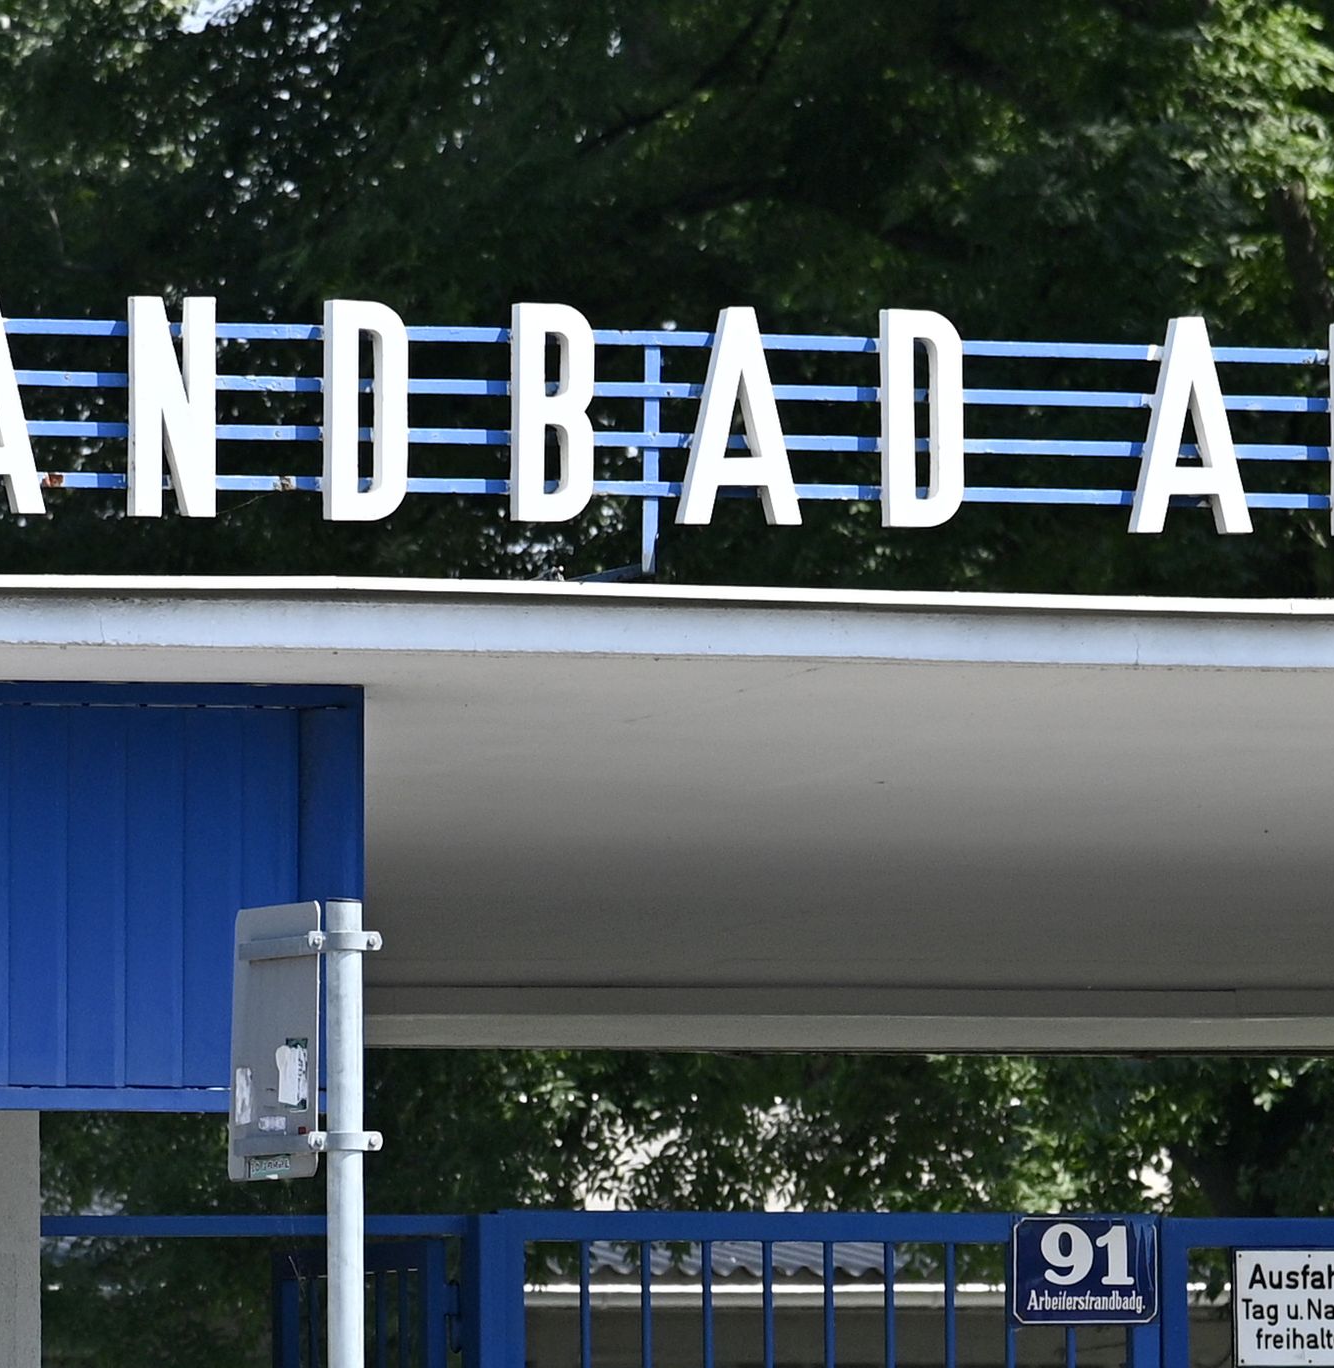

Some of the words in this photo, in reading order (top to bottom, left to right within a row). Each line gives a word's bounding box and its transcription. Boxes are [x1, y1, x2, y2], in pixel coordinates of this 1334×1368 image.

[1040, 1222, 1135, 1286] 91
[1026, 1289, 1146, 1314] Arbeiterstrandbadg.
[1241, 1298, 1279, 1327] Tag
